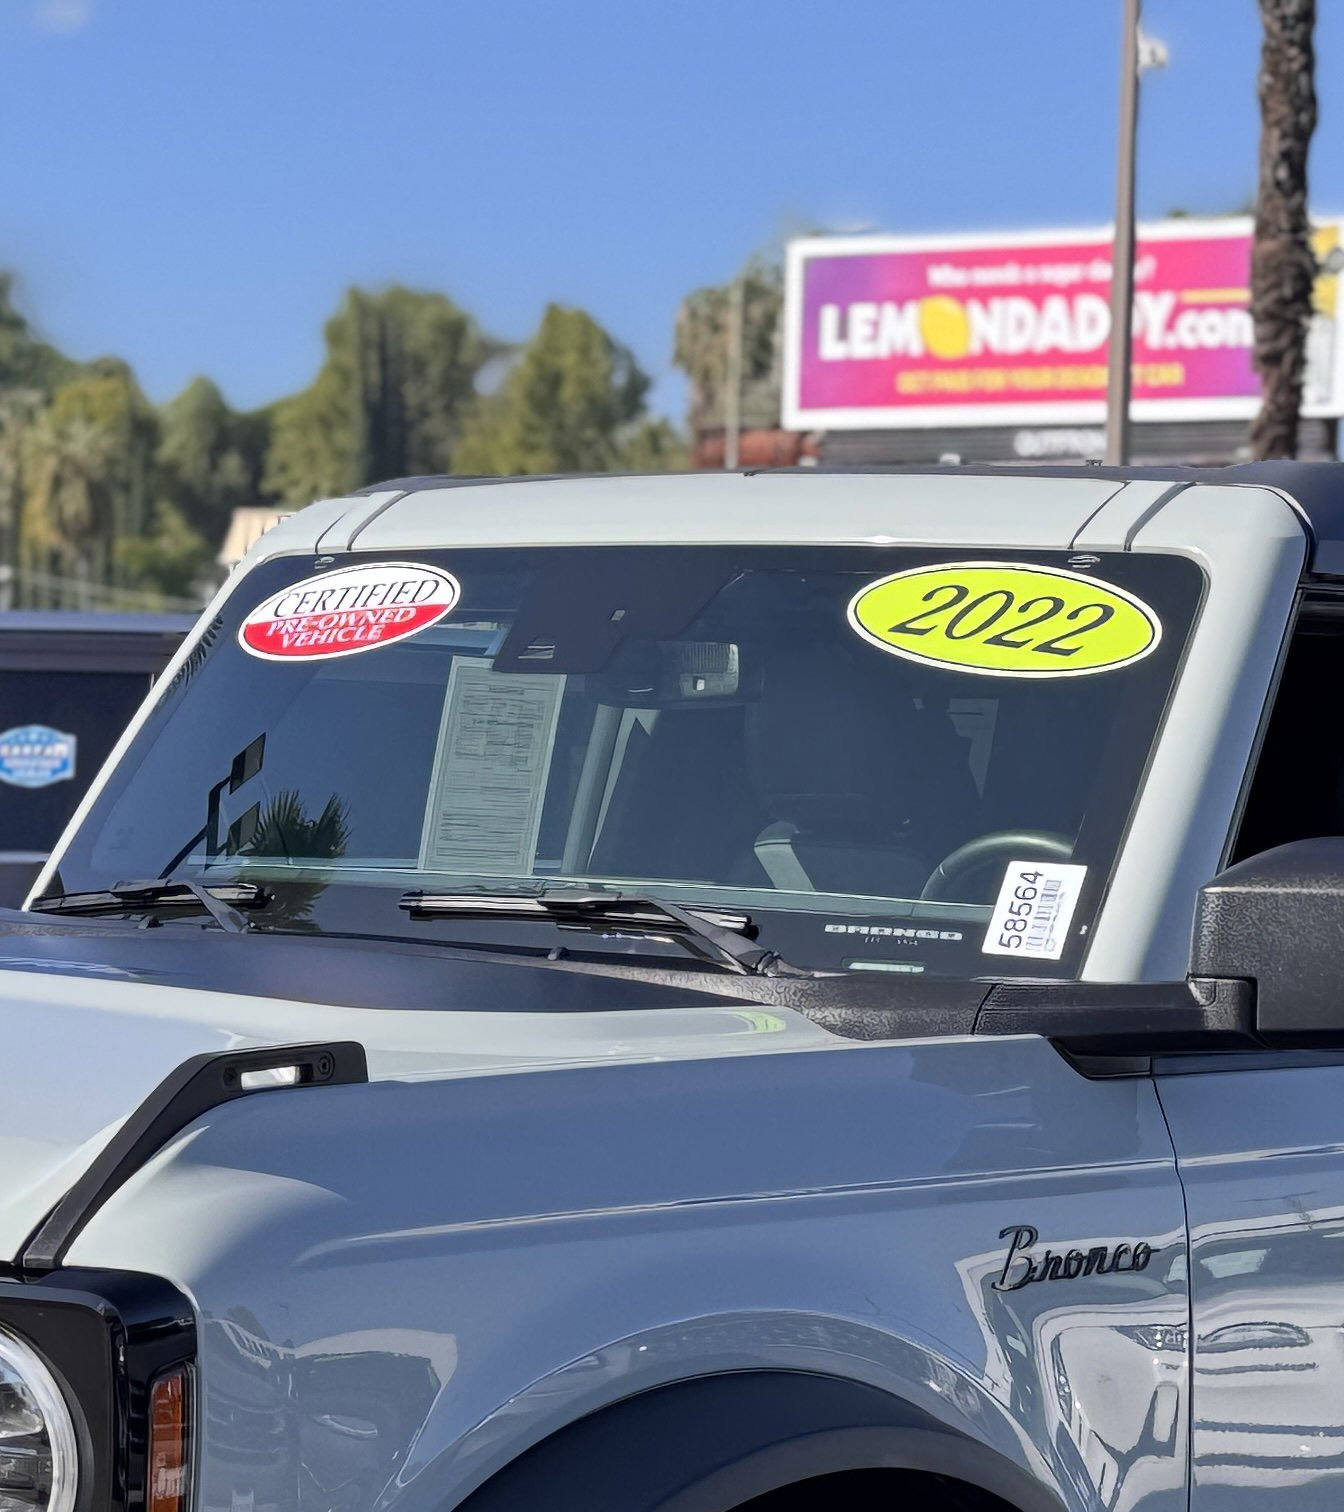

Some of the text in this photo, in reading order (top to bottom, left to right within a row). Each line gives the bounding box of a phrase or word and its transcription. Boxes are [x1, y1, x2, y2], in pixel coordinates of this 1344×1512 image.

[266, 607, 417, 637] PRE-OWNED
[273, 579, 440, 617] CERTIFIED
[888, 584, 1115, 656] 2022
[281, 624, 385, 648] VEHICLE
[998, 870, 1044, 949] 58564
[991, 1225, 1161, 1291] Bronco
